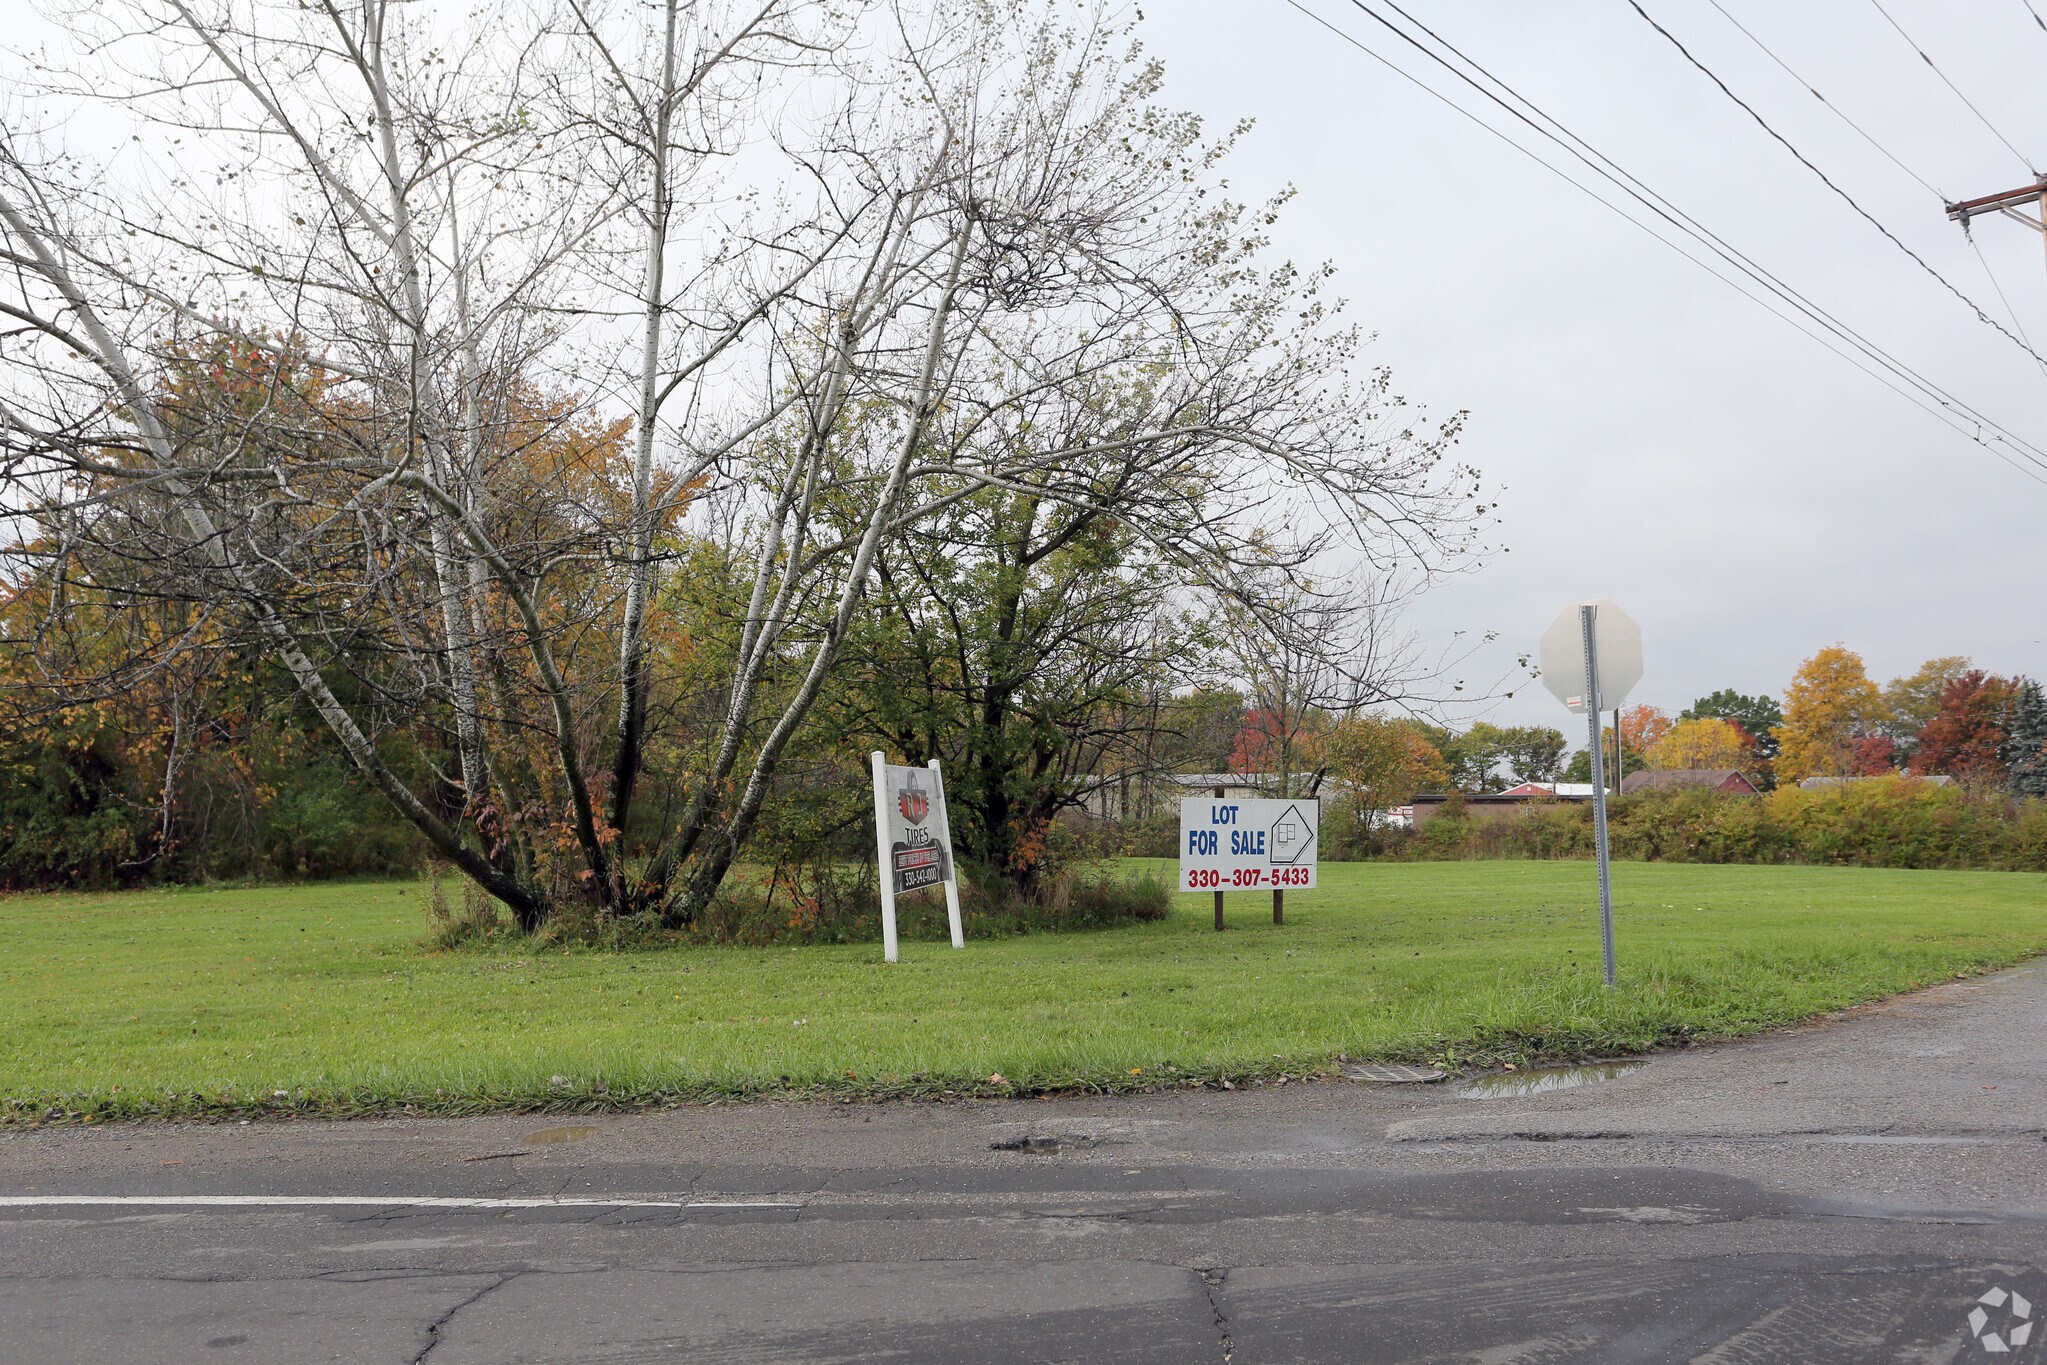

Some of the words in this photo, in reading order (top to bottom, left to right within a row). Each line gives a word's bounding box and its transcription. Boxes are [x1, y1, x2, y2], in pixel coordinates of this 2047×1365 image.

[1211, 805, 1239, 825] LOT
[905, 826, 929, 845] TIRES
[1188, 830, 1218, 856] FOR
[1231, 830, 1266, 856] SALE
[1188, 867, 1309, 888] 330-307-5433
